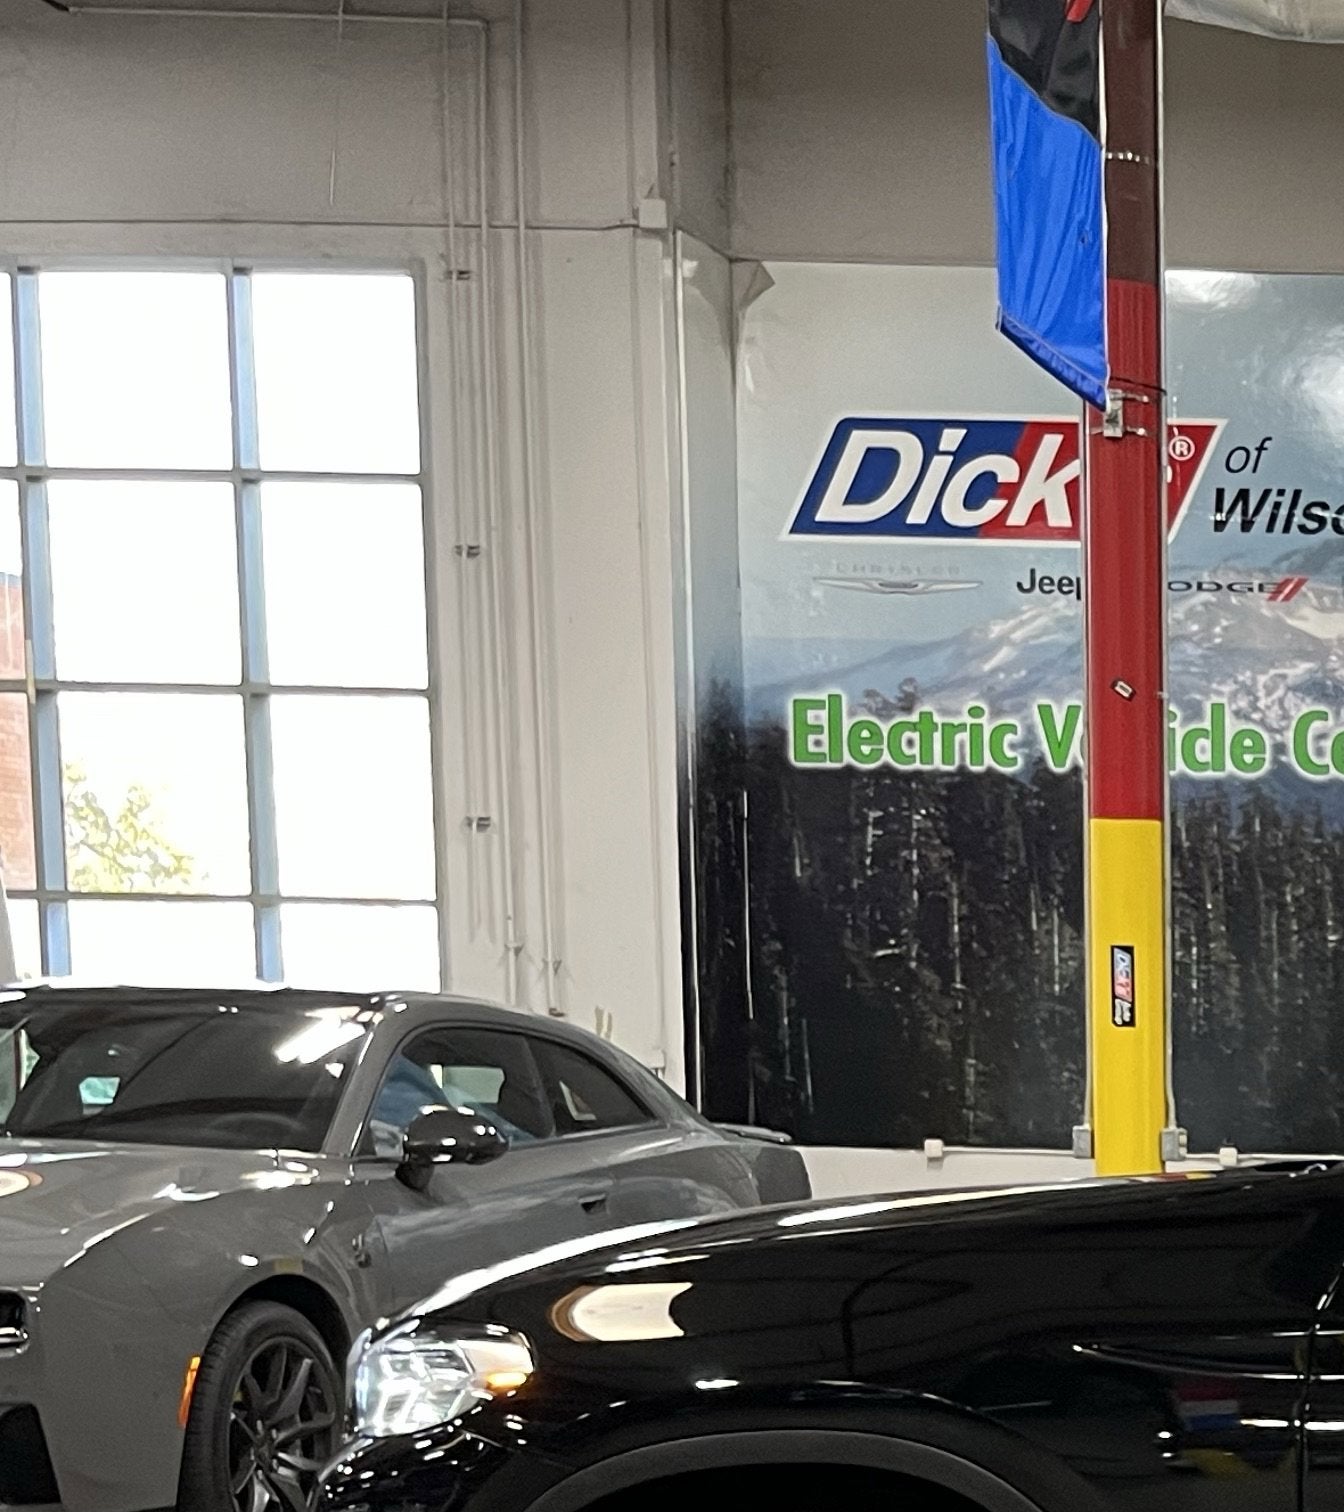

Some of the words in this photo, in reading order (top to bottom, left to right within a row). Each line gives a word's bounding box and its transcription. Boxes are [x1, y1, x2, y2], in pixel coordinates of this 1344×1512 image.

[815, 427, 1173, 529] Dick
[1225, 436, 1273, 474] of
[1168, 580, 1282, 593] ODGE
[793, 693, 1019, 769] Electric
[1036, 702, 1266, 774] Vicle
